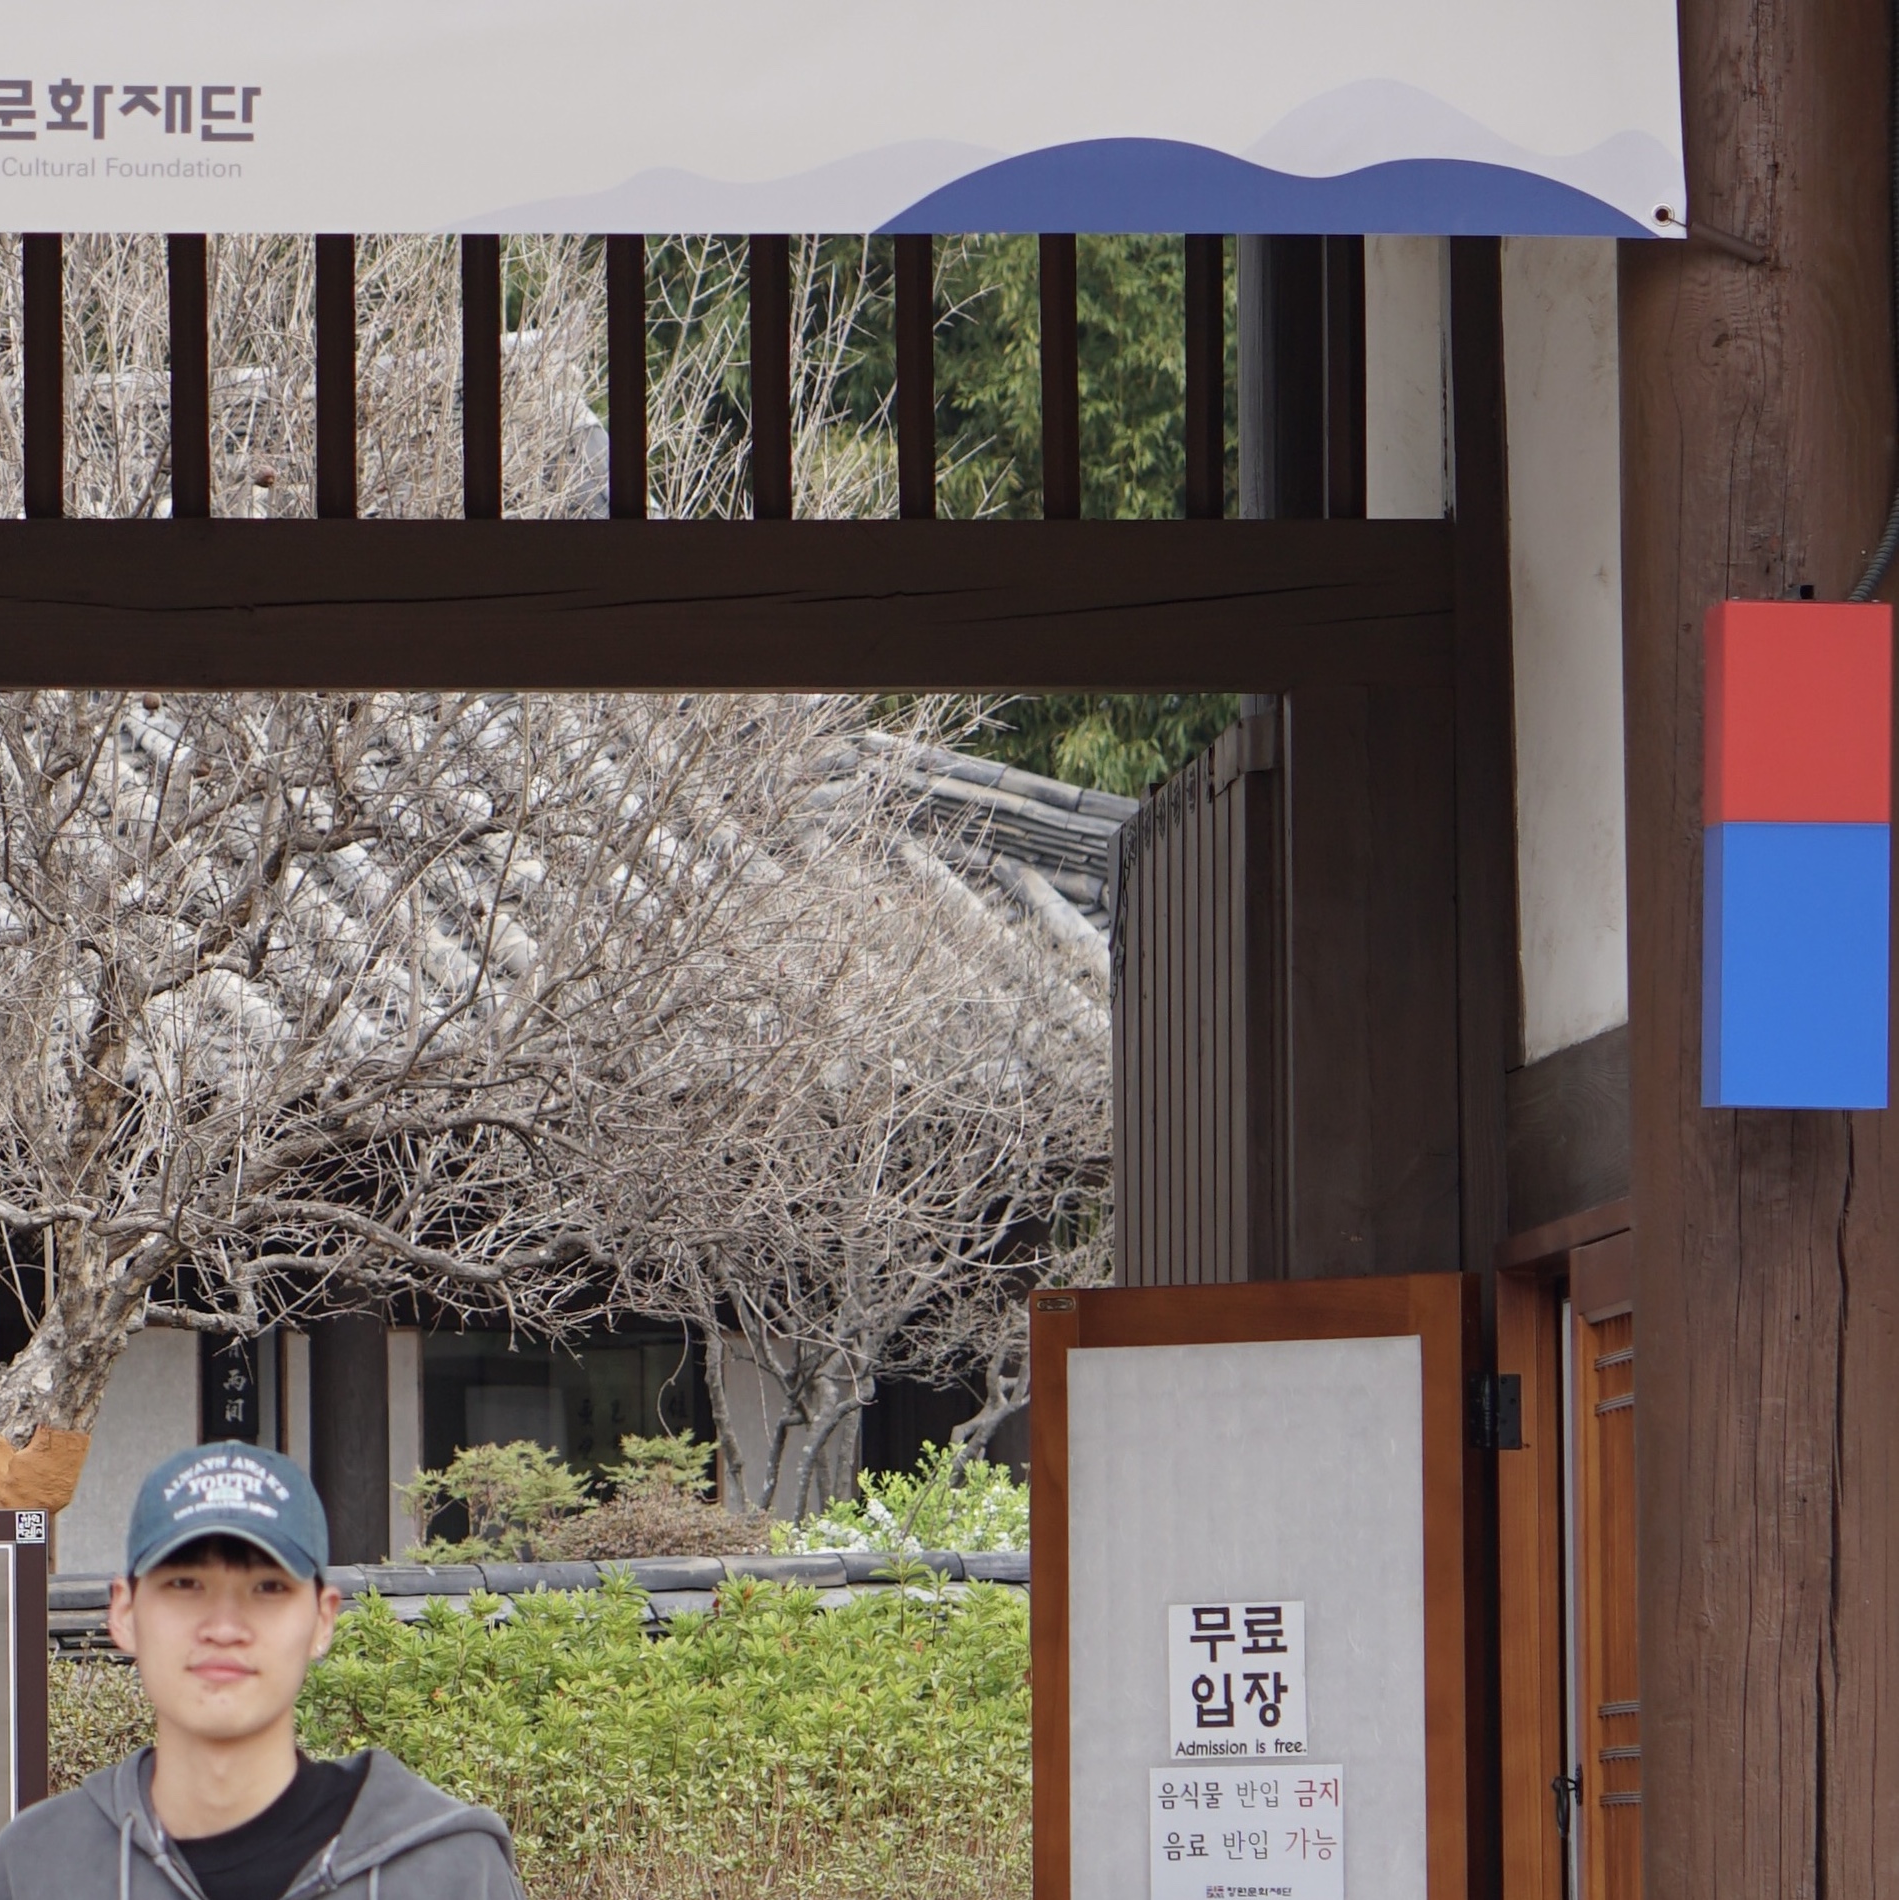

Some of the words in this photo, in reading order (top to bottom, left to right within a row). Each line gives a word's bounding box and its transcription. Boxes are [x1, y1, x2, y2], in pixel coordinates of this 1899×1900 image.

[2, 157, 95, 177] Cultural
[106, 157, 241, 178] Foundation
[187, 1472, 263, 1496] YOUTH
[1190, 1606, 1287, 1662] 무료
[1192, 1672, 1288, 1728] 입장
[1176, 1740, 1247, 1756] Admission
[1256, 1739, 1266, 1753] is
[1275, 1739, 1306, 1753] free.
[1158, 1782, 1223, 1809] 음식물
[1236, 1780, 1278, 1808] 반입
[1294, 1778, 1338, 1807] 금지
[1163, 1832, 1209, 1861] 음료
[1223, 1830, 1267, 1860] 반입
[1286, 1828, 1337, 1860] 가능
